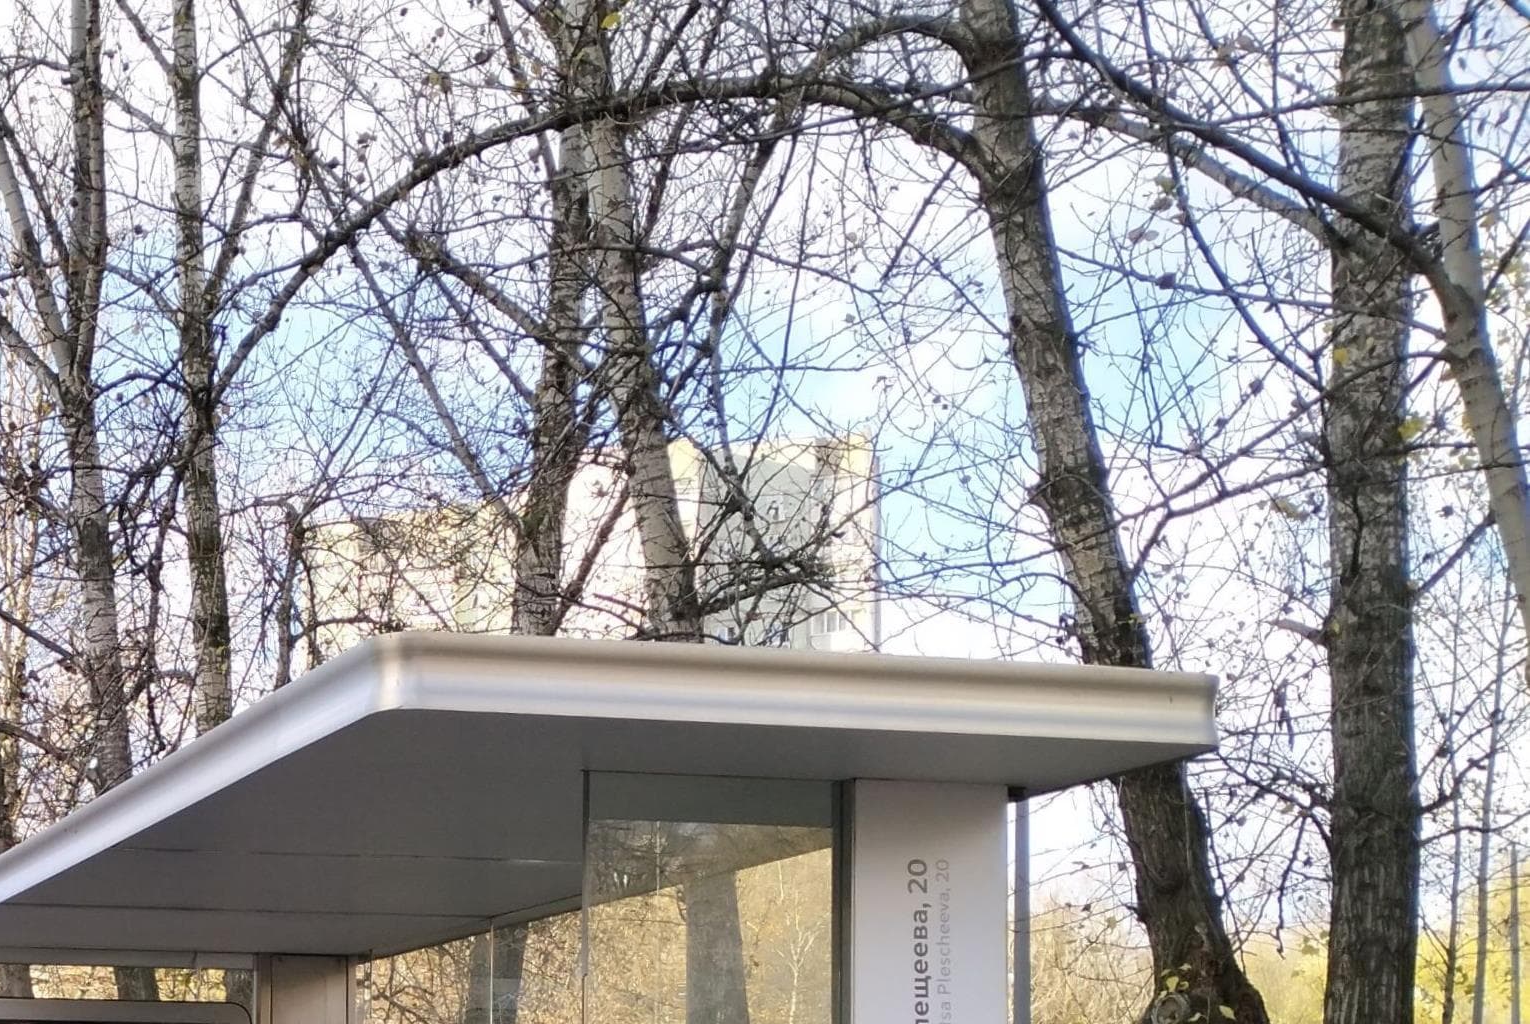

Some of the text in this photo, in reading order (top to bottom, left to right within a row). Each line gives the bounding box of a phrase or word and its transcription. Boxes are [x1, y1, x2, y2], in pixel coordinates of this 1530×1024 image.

[907, 858, 929, 893] 20
[935, 858, 950, 881] 20
[936, 888, 954, 994] Plescheeva,
